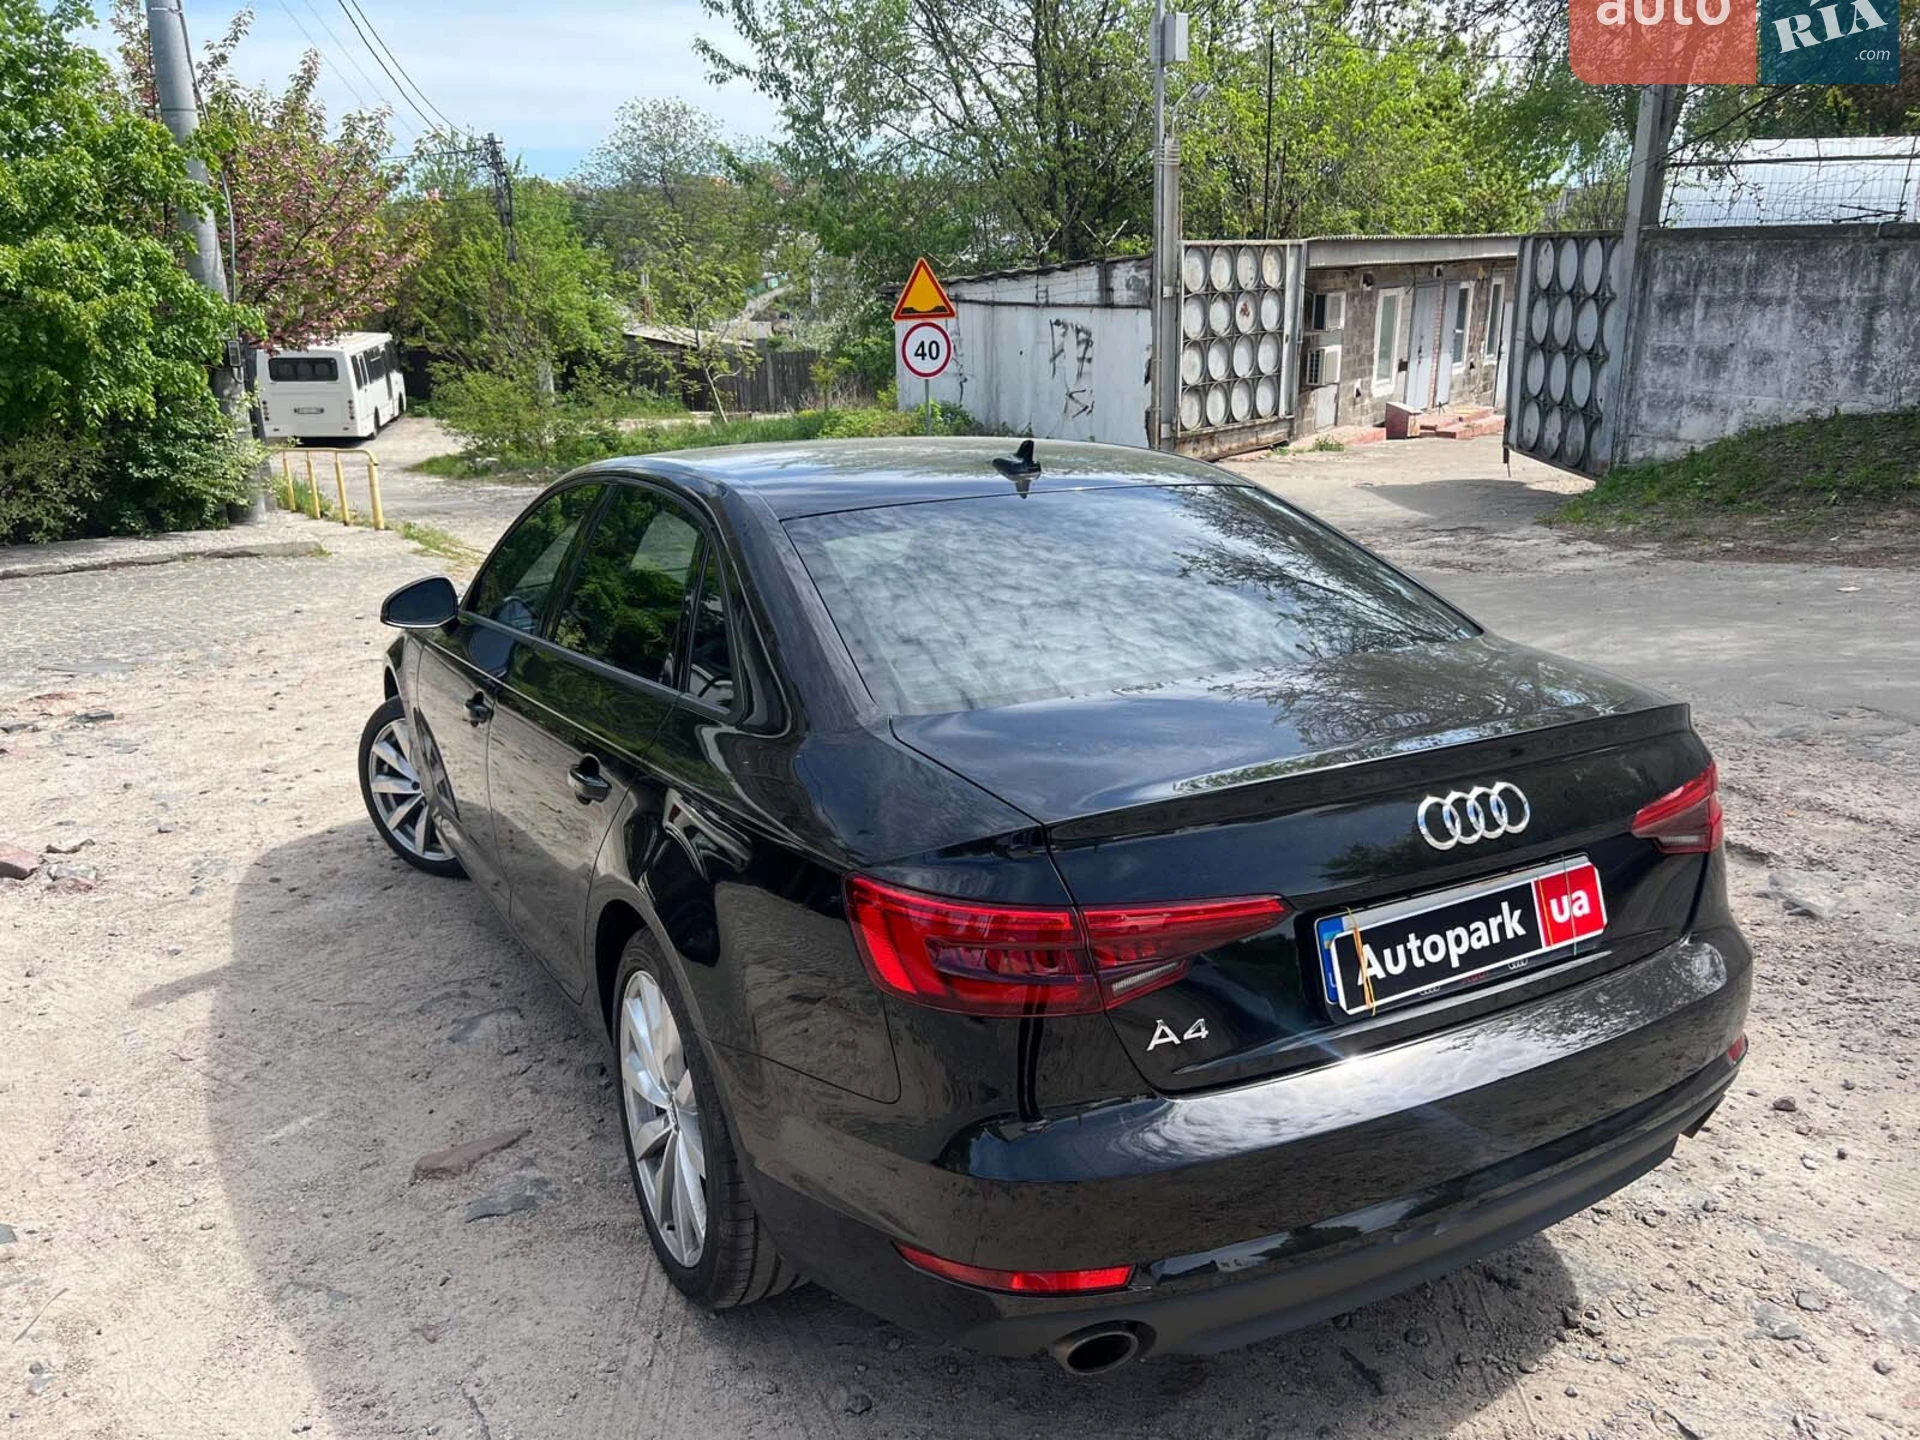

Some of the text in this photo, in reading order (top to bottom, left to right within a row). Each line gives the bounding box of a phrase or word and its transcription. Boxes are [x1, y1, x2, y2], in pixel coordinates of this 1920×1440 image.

[914, 340, 940, 361] 40
[1357, 890, 1590, 985] Autopark ua
[1146, 1018, 1209, 1052] A4
